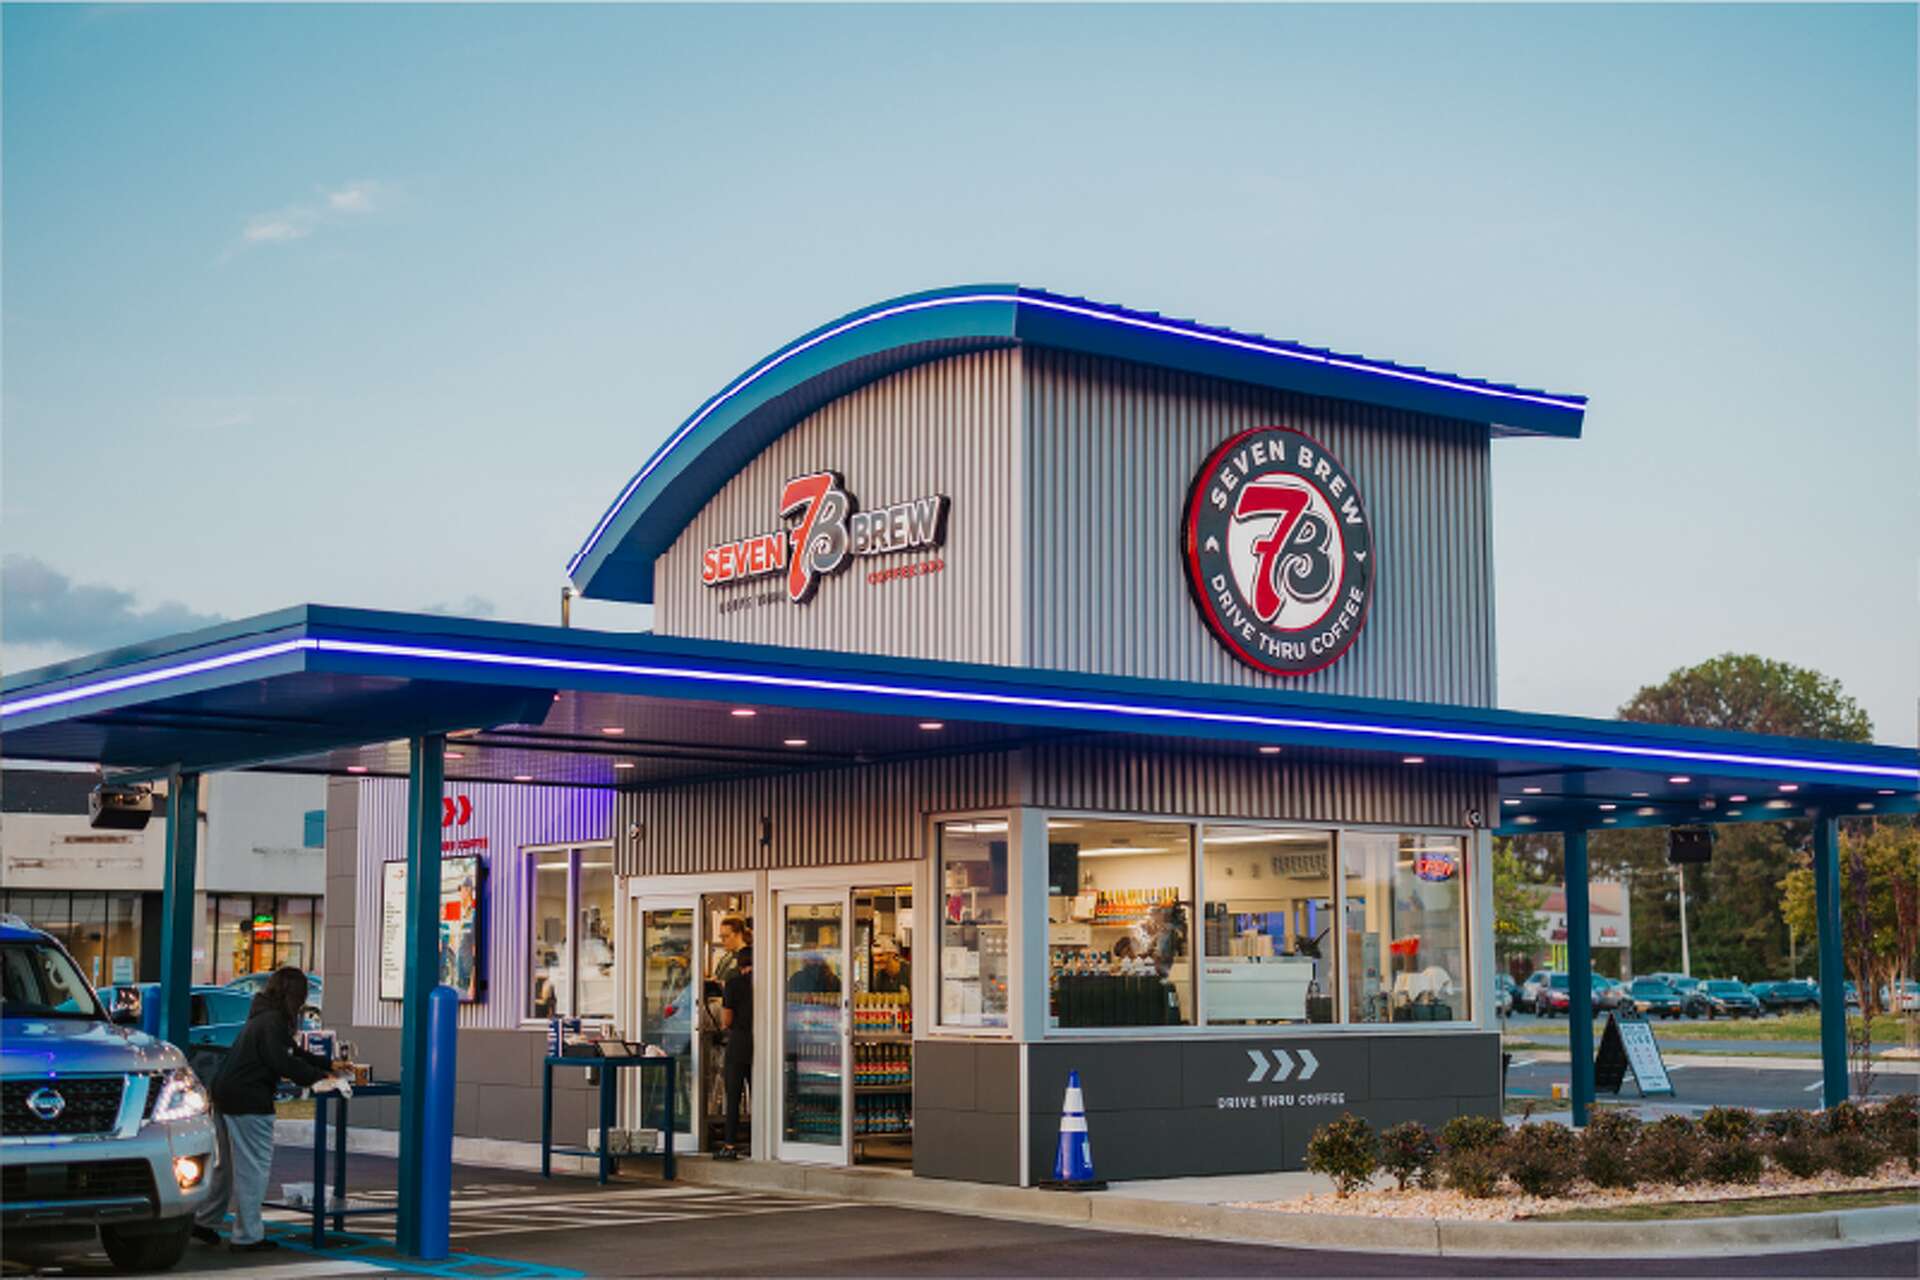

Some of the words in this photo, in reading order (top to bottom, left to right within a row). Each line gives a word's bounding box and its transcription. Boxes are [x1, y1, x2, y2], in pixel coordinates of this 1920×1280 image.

[1211, 440, 1286, 510] SEVEN
[1297, 445, 1363, 525] BREW
[703, 532, 785, 585] SEVEN
[852, 496, 943, 555] BREW
[1212, 574, 1257, 640] DRIVE
[1259, 631, 1306, 660] THRU
[1310, 587, 1364, 654] COFFEE
[1218, 1097, 1257, 1109] DRIVE
[1262, 1094, 1295, 1107] THRU
[1299, 1092, 1345, 1106] COFFEE
